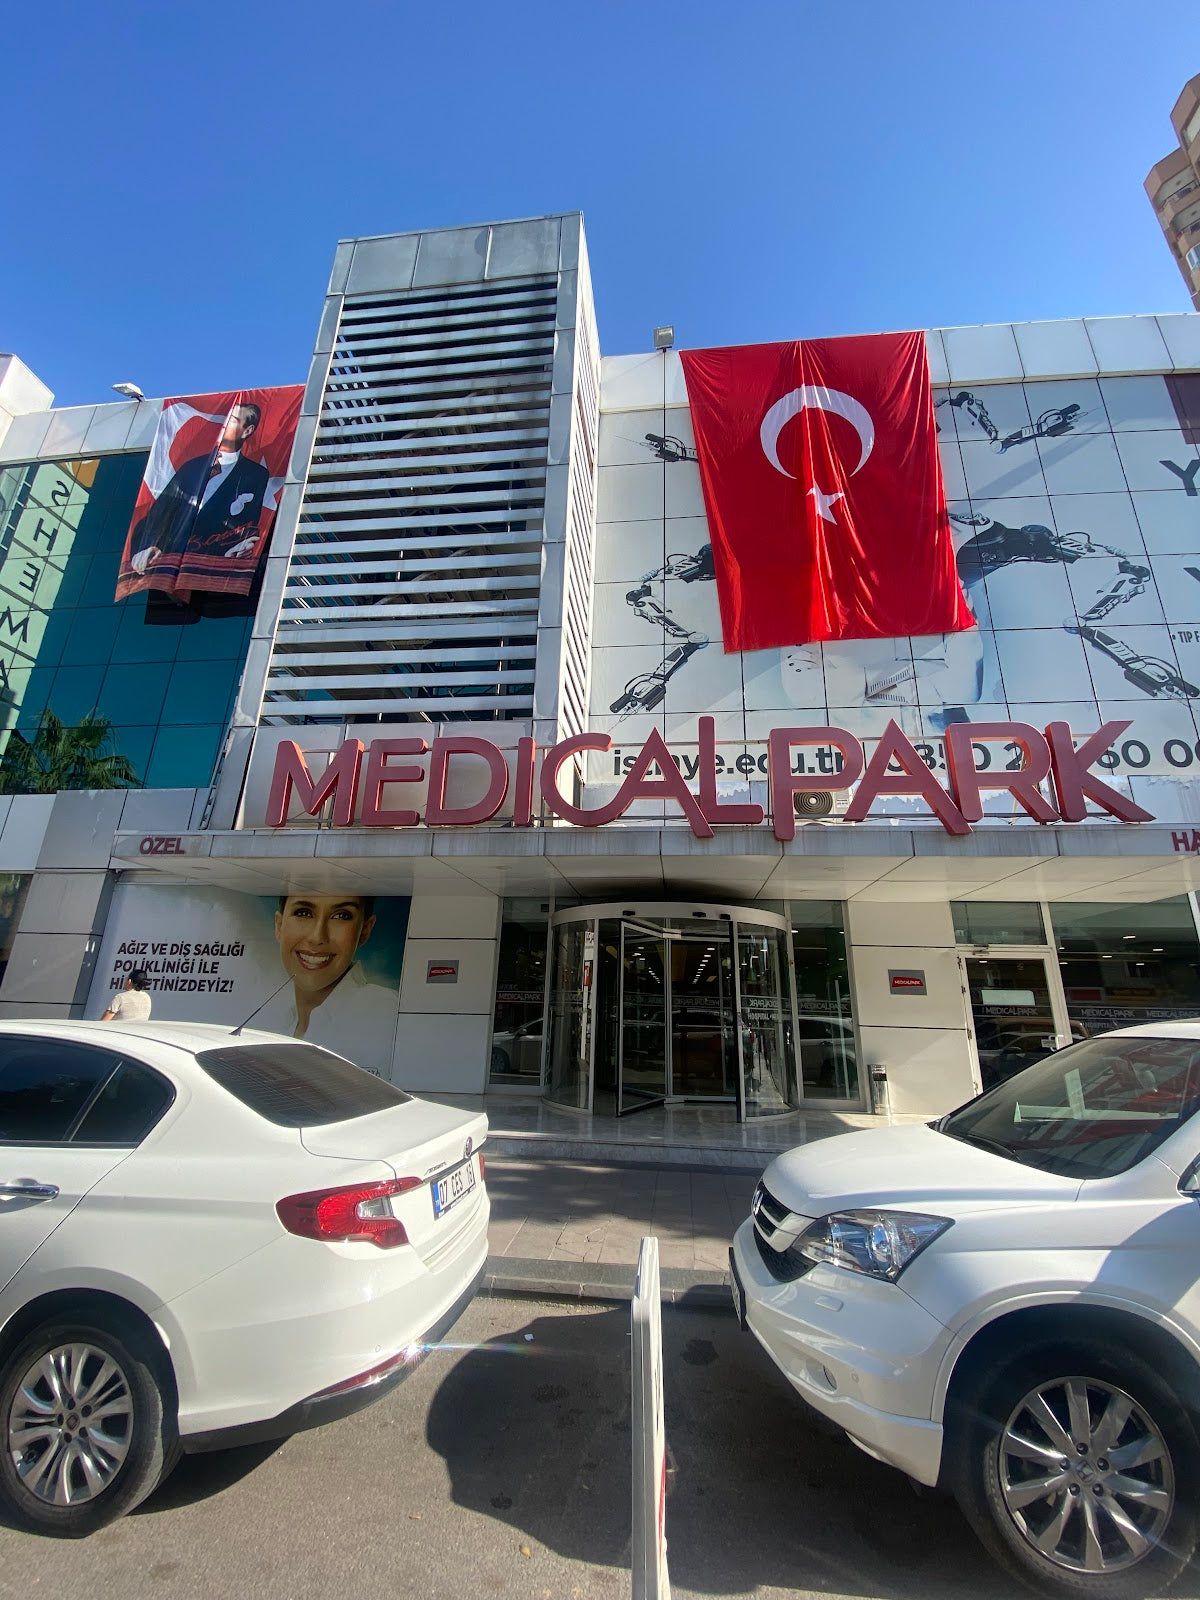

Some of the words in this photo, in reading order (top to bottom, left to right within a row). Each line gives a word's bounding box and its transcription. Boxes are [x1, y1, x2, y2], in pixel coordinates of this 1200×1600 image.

[139, 836, 186, 855] ÖZEL
[117, 940, 147, 956] AĞIZ
[151, 943, 168, 956] VE
[169, 941, 191, 958] DİŞ
[193, 941, 245, 957] SAĞLIĞI
[113, 958, 196, 974] POLİKLİNİĞİ
[198, 959, 220, 975] İLE
[110, 975, 234, 993] HİETİNİZDEYİZ!
